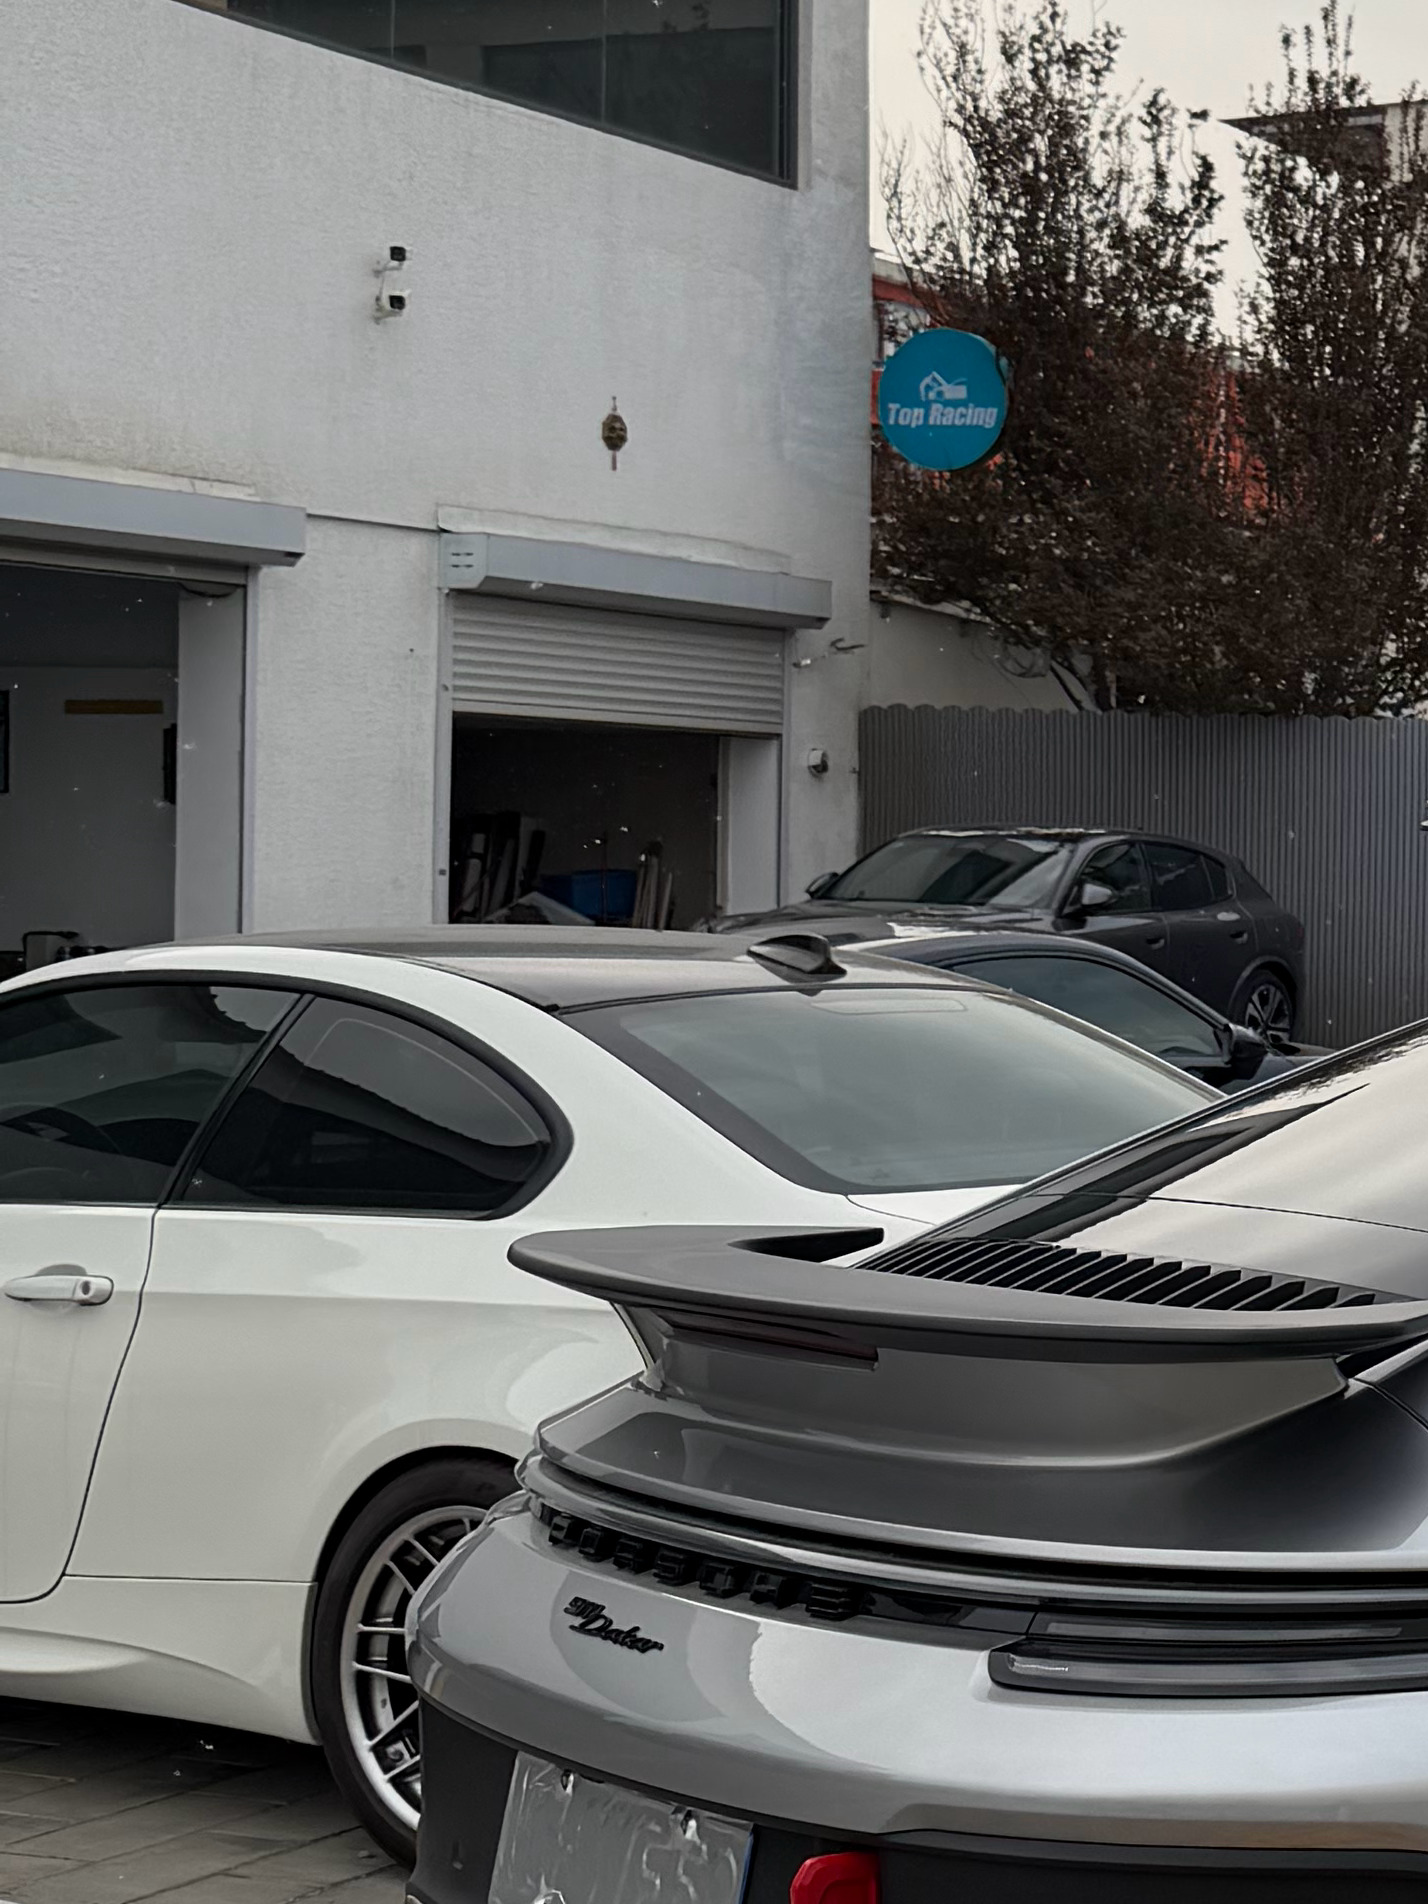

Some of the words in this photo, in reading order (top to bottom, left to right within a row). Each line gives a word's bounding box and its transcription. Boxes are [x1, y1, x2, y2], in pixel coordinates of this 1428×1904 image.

[887, 402, 925, 428] Top
[928, 402, 998, 428] Racing
[568, 1612, 665, 1654] Dakar
